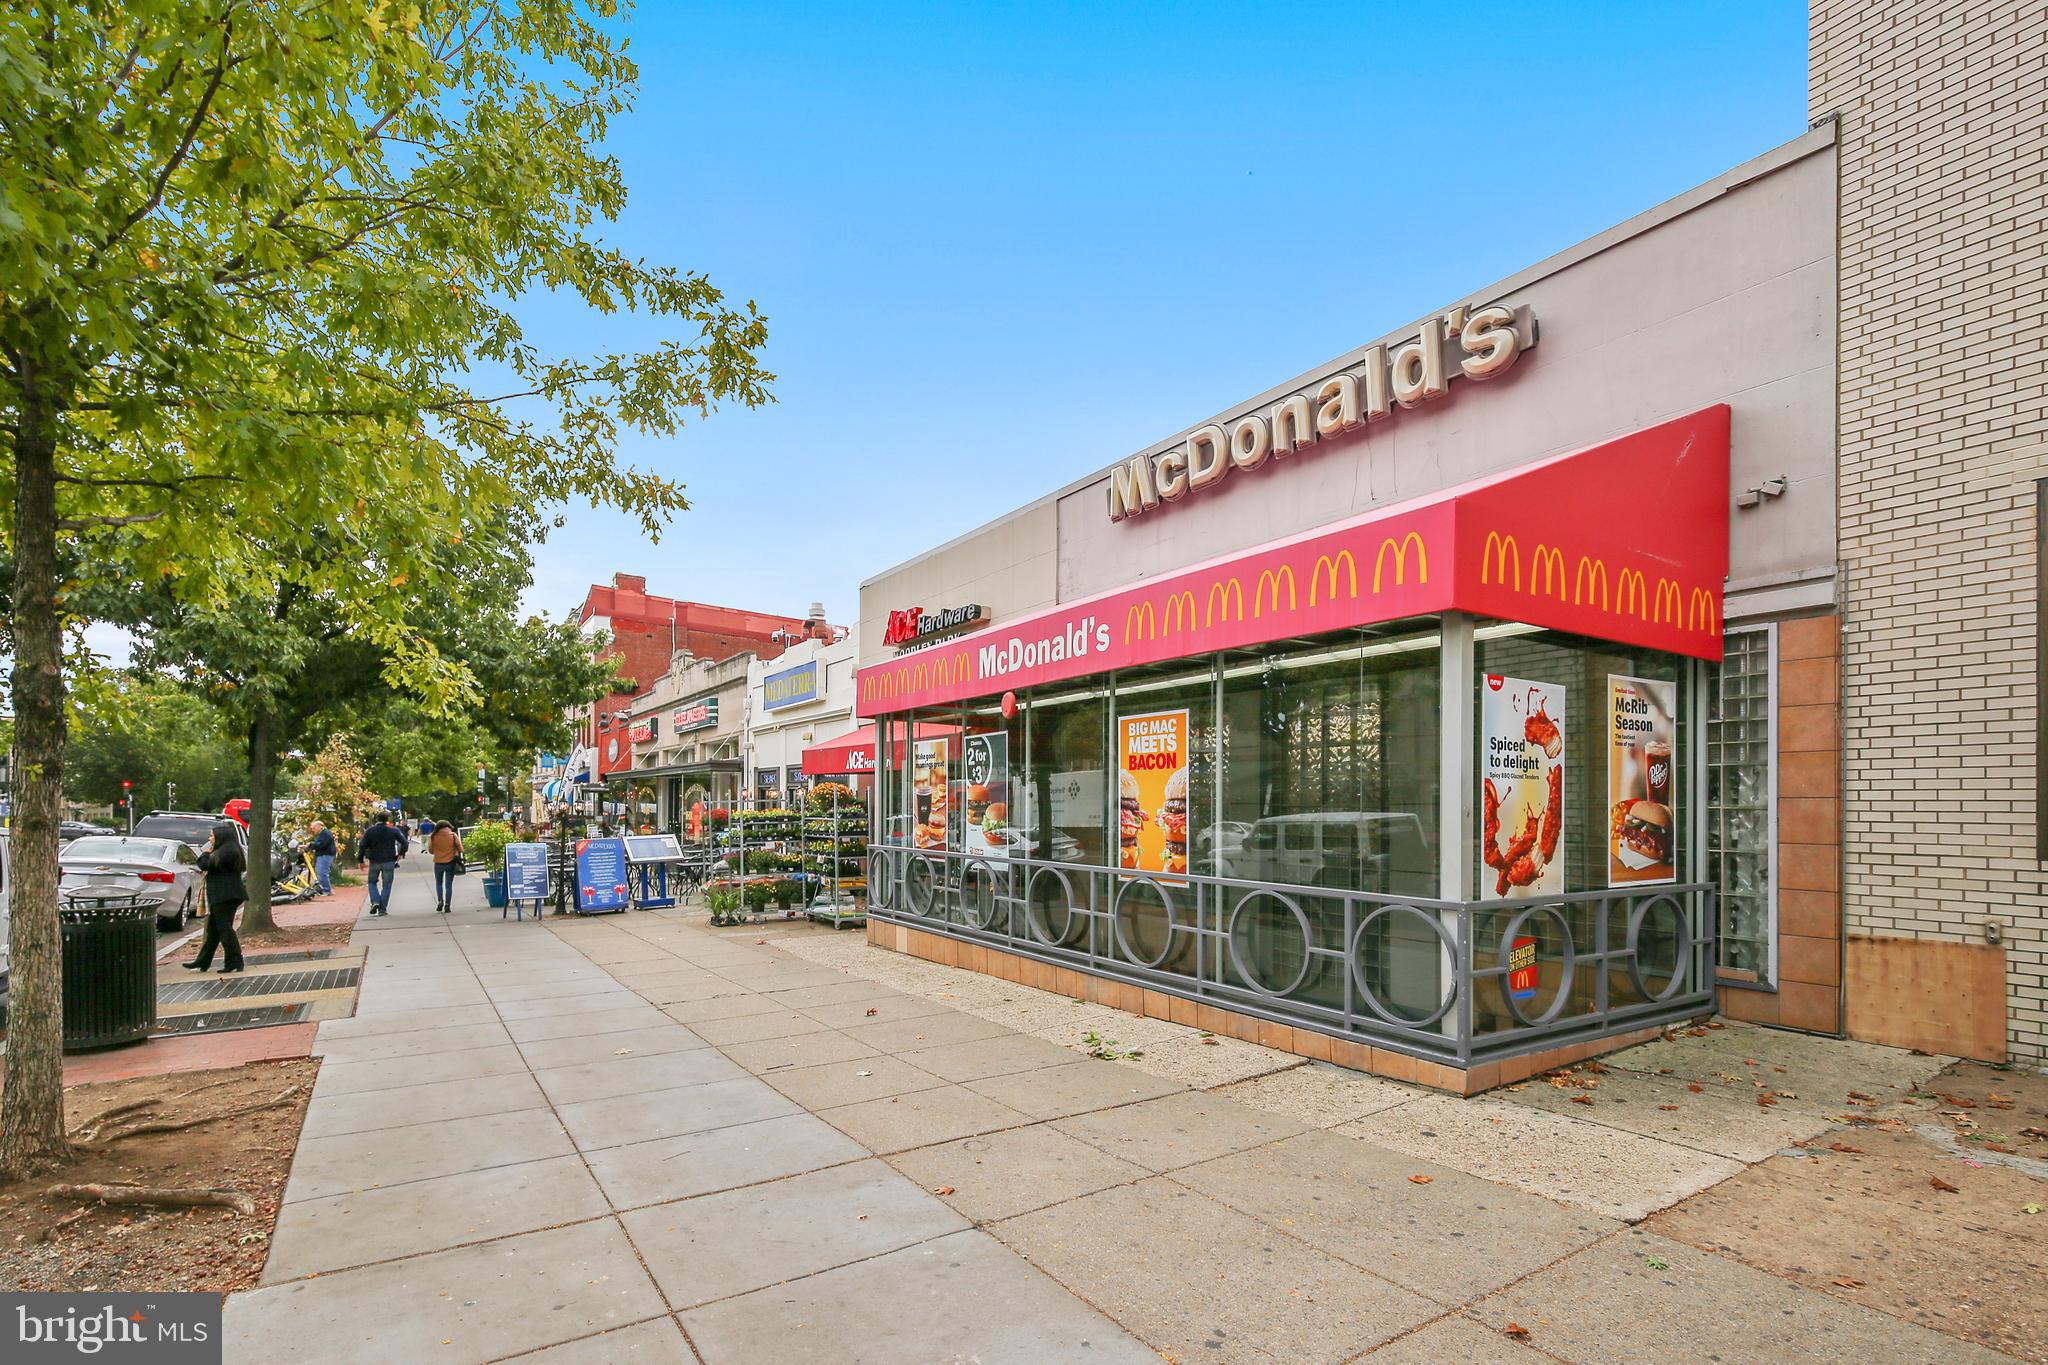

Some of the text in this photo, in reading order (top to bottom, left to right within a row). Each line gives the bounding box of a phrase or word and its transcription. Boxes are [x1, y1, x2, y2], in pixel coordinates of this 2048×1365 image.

[1108, 303, 1521, 523] McDonald's
[883, 603, 977, 646] ACE Hardware
[978, 616, 1111, 679] McDonald's
[1615, 697, 1648, 714] McRib
[1128, 718, 1177, 736] BIG MAC
[1615, 714, 1653, 732] Season
[1128, 733, 1177, 754] MEETS
[1490, 736, 1525, 754] Spiced
[846, 749, 864, 769] ACE
[926, 752, 936, 761] good
[967, 748, 986, 765] 2 for
[1128, 752, 1177, 771] BACON
[1490, 754, 1540, 773] to delight
[1509, 944, 1536, 963] ELEVATOR
